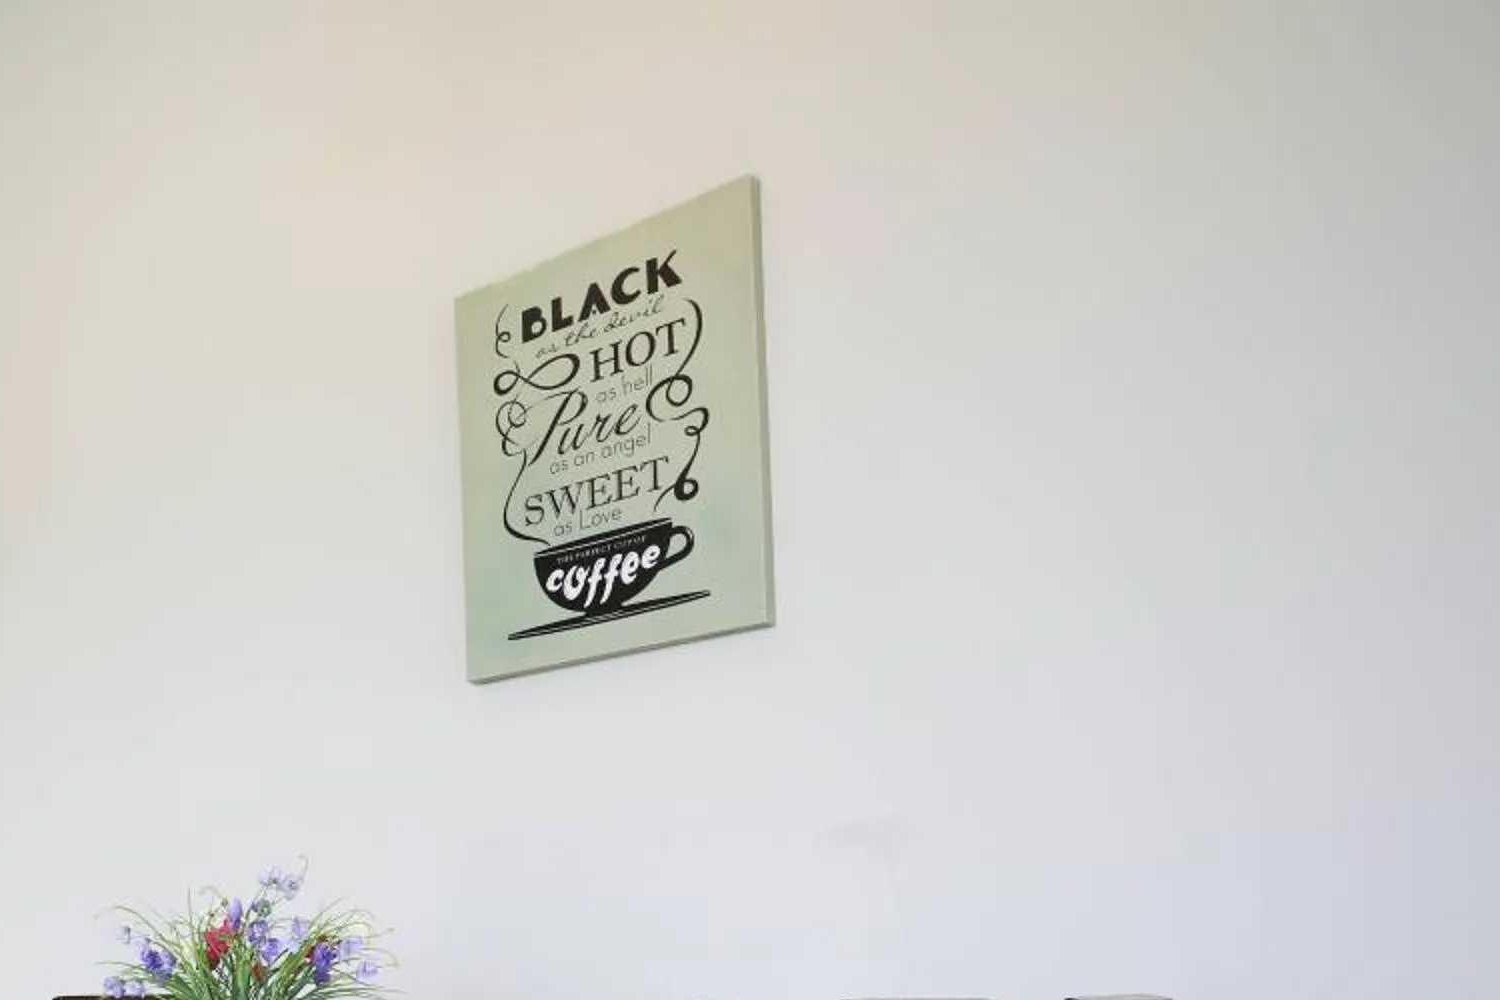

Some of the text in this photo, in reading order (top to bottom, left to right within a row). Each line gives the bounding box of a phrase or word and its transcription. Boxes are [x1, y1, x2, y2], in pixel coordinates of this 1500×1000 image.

[521, 250, 682, 344] BLACK
[589, 317, 687, 382] HOT
[621, 363, 653, 395] hell
[528, 386, 641, 467] Pure
[549, 421, 651, 475] as an angel
[524, 455, 669, 527] SWEET
[553, 507, 622, 537] as Love
[545, 544, 661, 608] coffee
